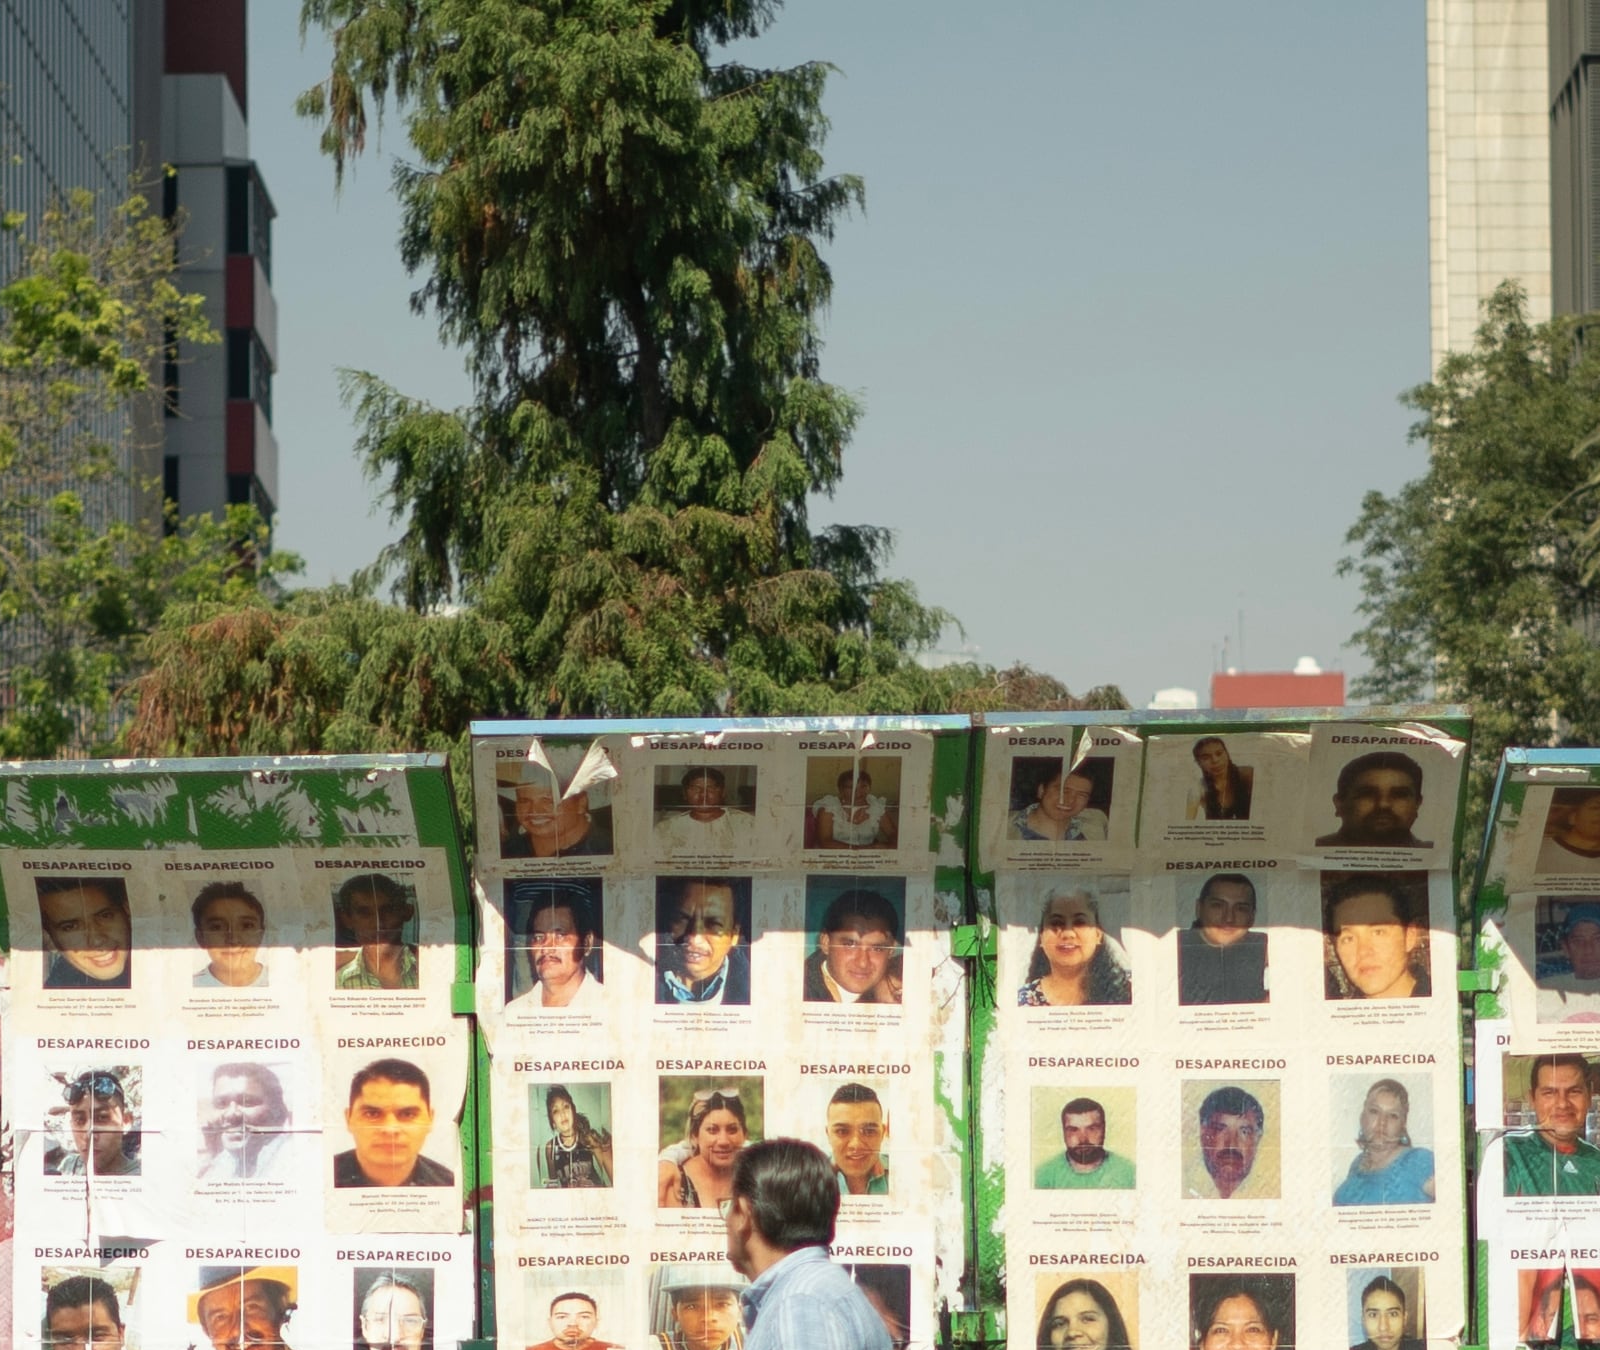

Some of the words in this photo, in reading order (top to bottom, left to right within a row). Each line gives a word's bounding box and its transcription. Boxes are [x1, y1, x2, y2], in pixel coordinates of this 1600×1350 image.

[798, 741, 912, 750] DESAPACIDO
[22, 861, 132, 871] DESAPARECIDO
[164, 860, 275, 871] DESAPARECIDO
[314, 860, 426, 870] DESAPARECIDO
[1165, 859, 1278, 871] DESAPARECIDO
[37, 1038, 150, 1049] DESAPARECIDO
[187, 1038, 300, 1050] DESAPARECIDO
[337, 1036, 446, 1049] DESAPARECIDO
[514, 1059, 625, 1072] DESAPARECIDA
[655, 1059, 767, 1071] DESAPARECIDA
[1028, 1056, 1140, 1068] DESAPARECIDO
[1175, 1058, 1287, 1070] DESAPARECIDO
[1326, 1054, 1436, 1066] DESAPARECIDA
[800, 1063, 911, 1075] DESAPARECIDO
[34, 1246, 150, 1259] DESAPARECIDO
[185, 1248, 301, 1259] DESAPARECIDO
[336, 1250, 452, 1262] DESAPARECIDO
[650, 1251, 731, 1262] DESAPARE
[825, 1245, 914, 1258] APARECIDO
[518, 1254, 630, 1268] DESAPARECIDO
[1029, 1253, 1146, 1265] DESAPARECIDA
[1187, 1256, 1298, 1268] DESAPARECIDA
[1329, 1251, 1440, 1265] DESAPARECIDO
